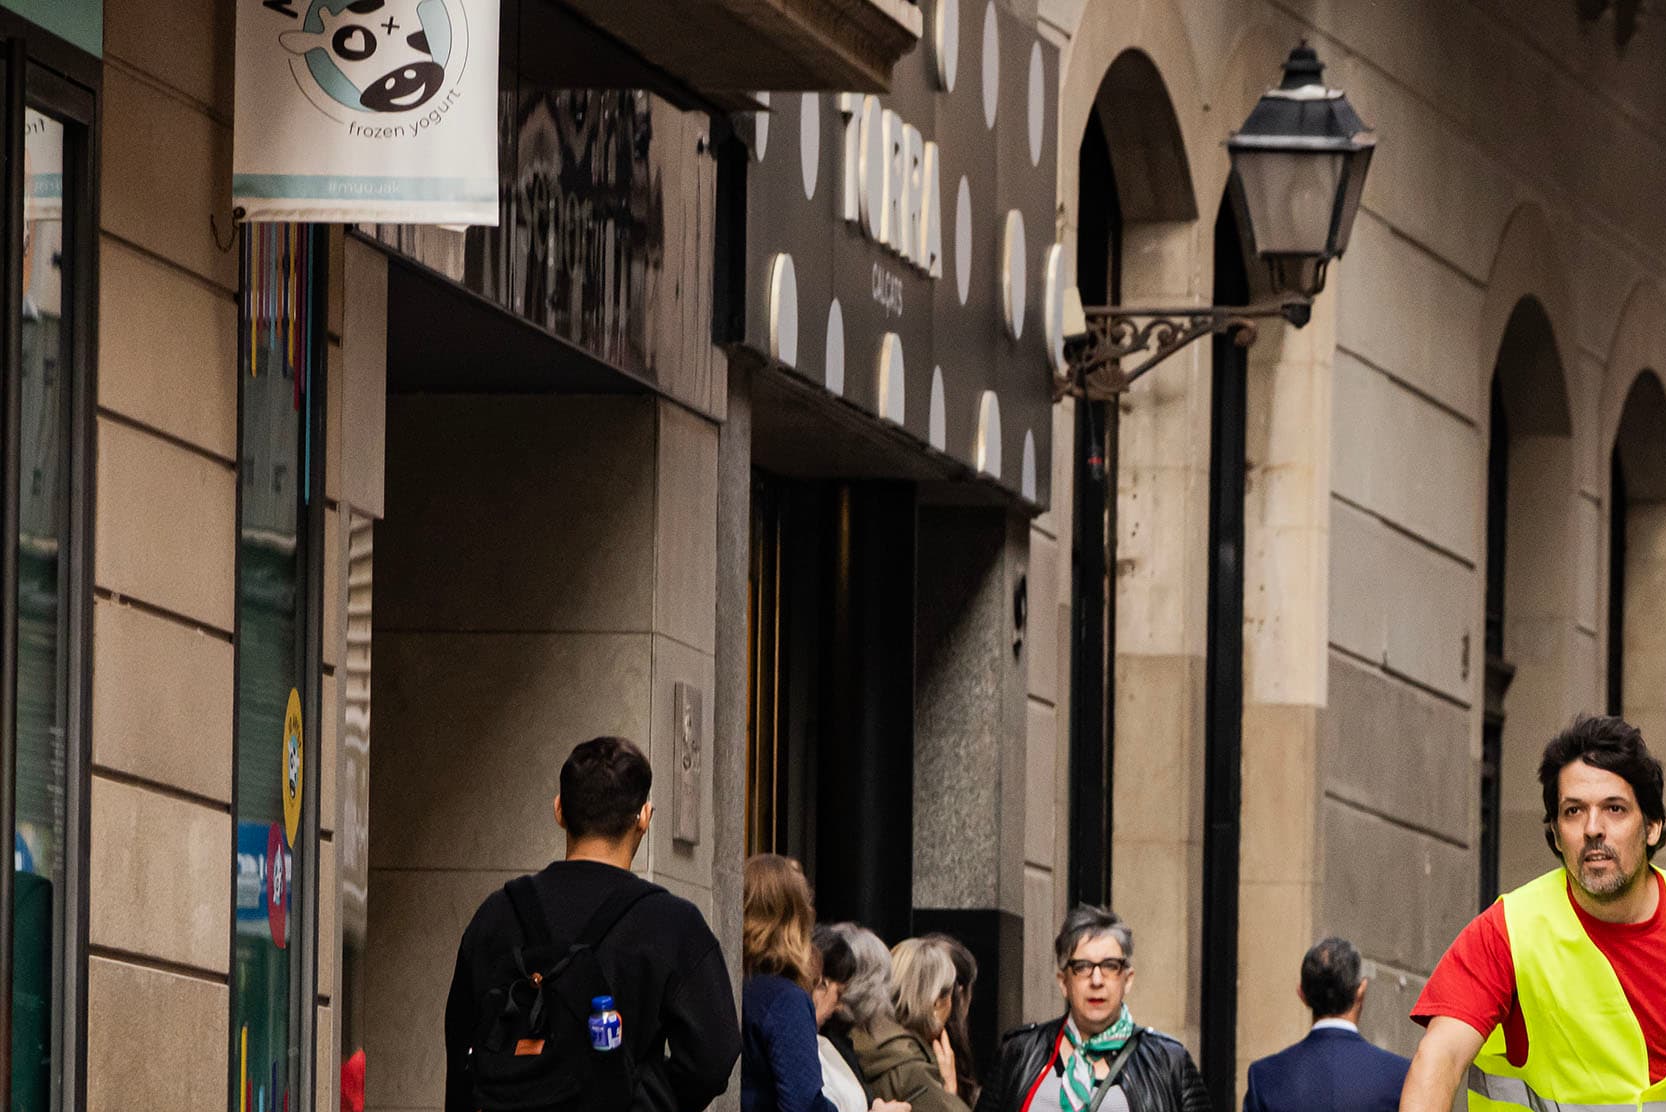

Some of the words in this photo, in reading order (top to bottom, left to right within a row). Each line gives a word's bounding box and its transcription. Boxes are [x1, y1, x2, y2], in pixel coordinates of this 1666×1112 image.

[349, 121, 405, 139] frozen
[410, 89, 461, 136] yogurt
[838, 91, 943, 279] TORRA
